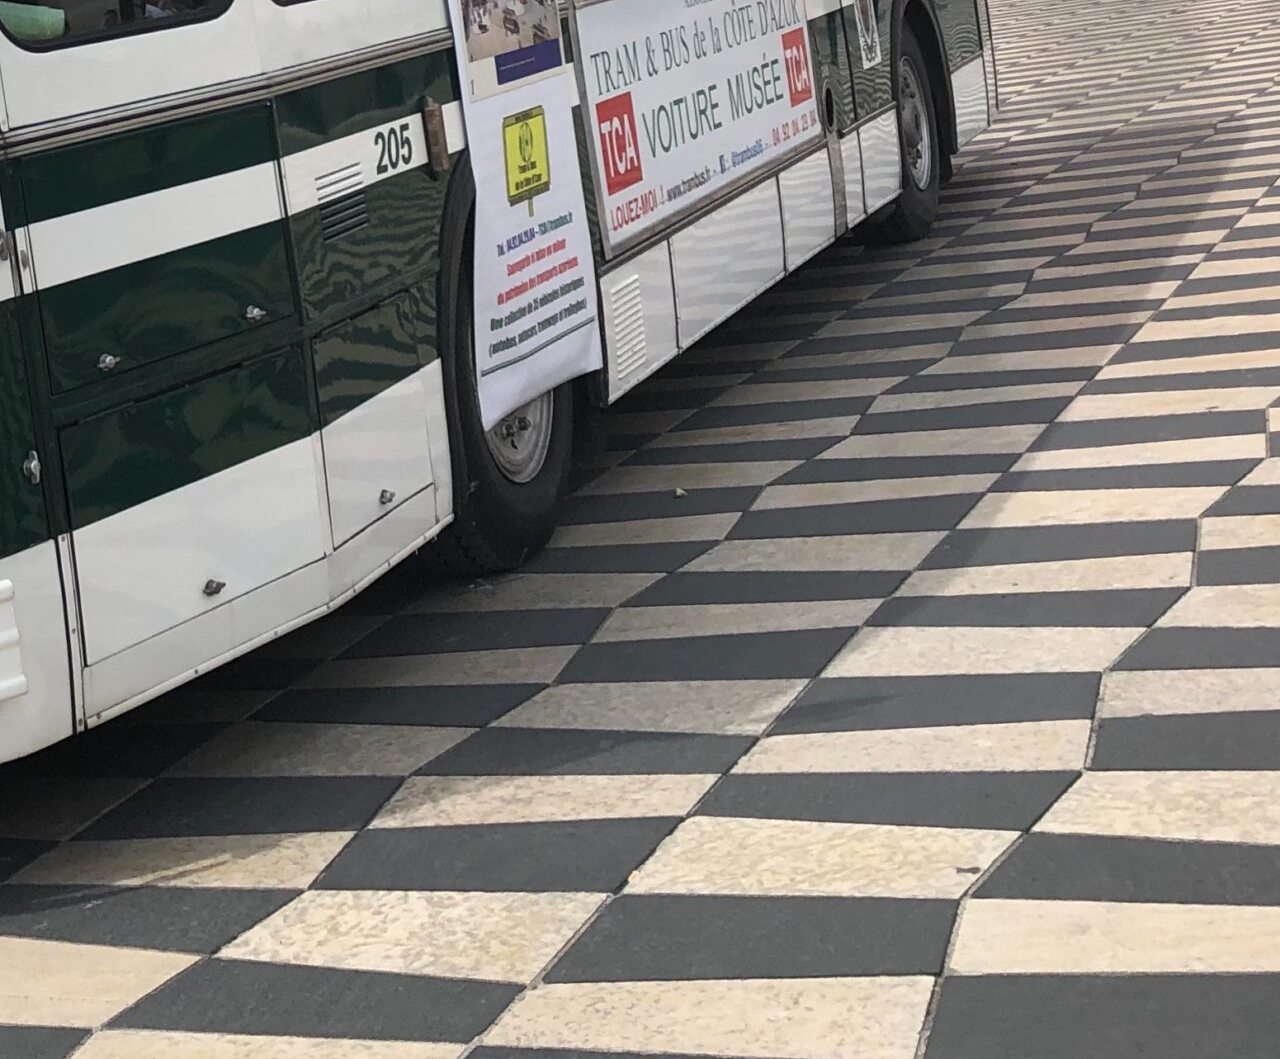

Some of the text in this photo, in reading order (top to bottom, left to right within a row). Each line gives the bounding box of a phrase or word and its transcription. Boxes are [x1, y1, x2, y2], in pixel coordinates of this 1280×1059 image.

[590, 41, 642, 96] TRAM
[645, 35, 659, 77] &
[659, 25, 690, 71] BUS
[693, 19, 707, 61] de
[708, 17, 723, 55] la
[723, 0, 757, 49] CÔTE
[785, 43, 810, 95] TCA
[642, 52, 784, 159] VOITURE MUSÉE
[374, 123, 413, 176] 205
[600, 113, 638, 178] TCA
[610, 188, 657, 231] LOUEZ-MOI
